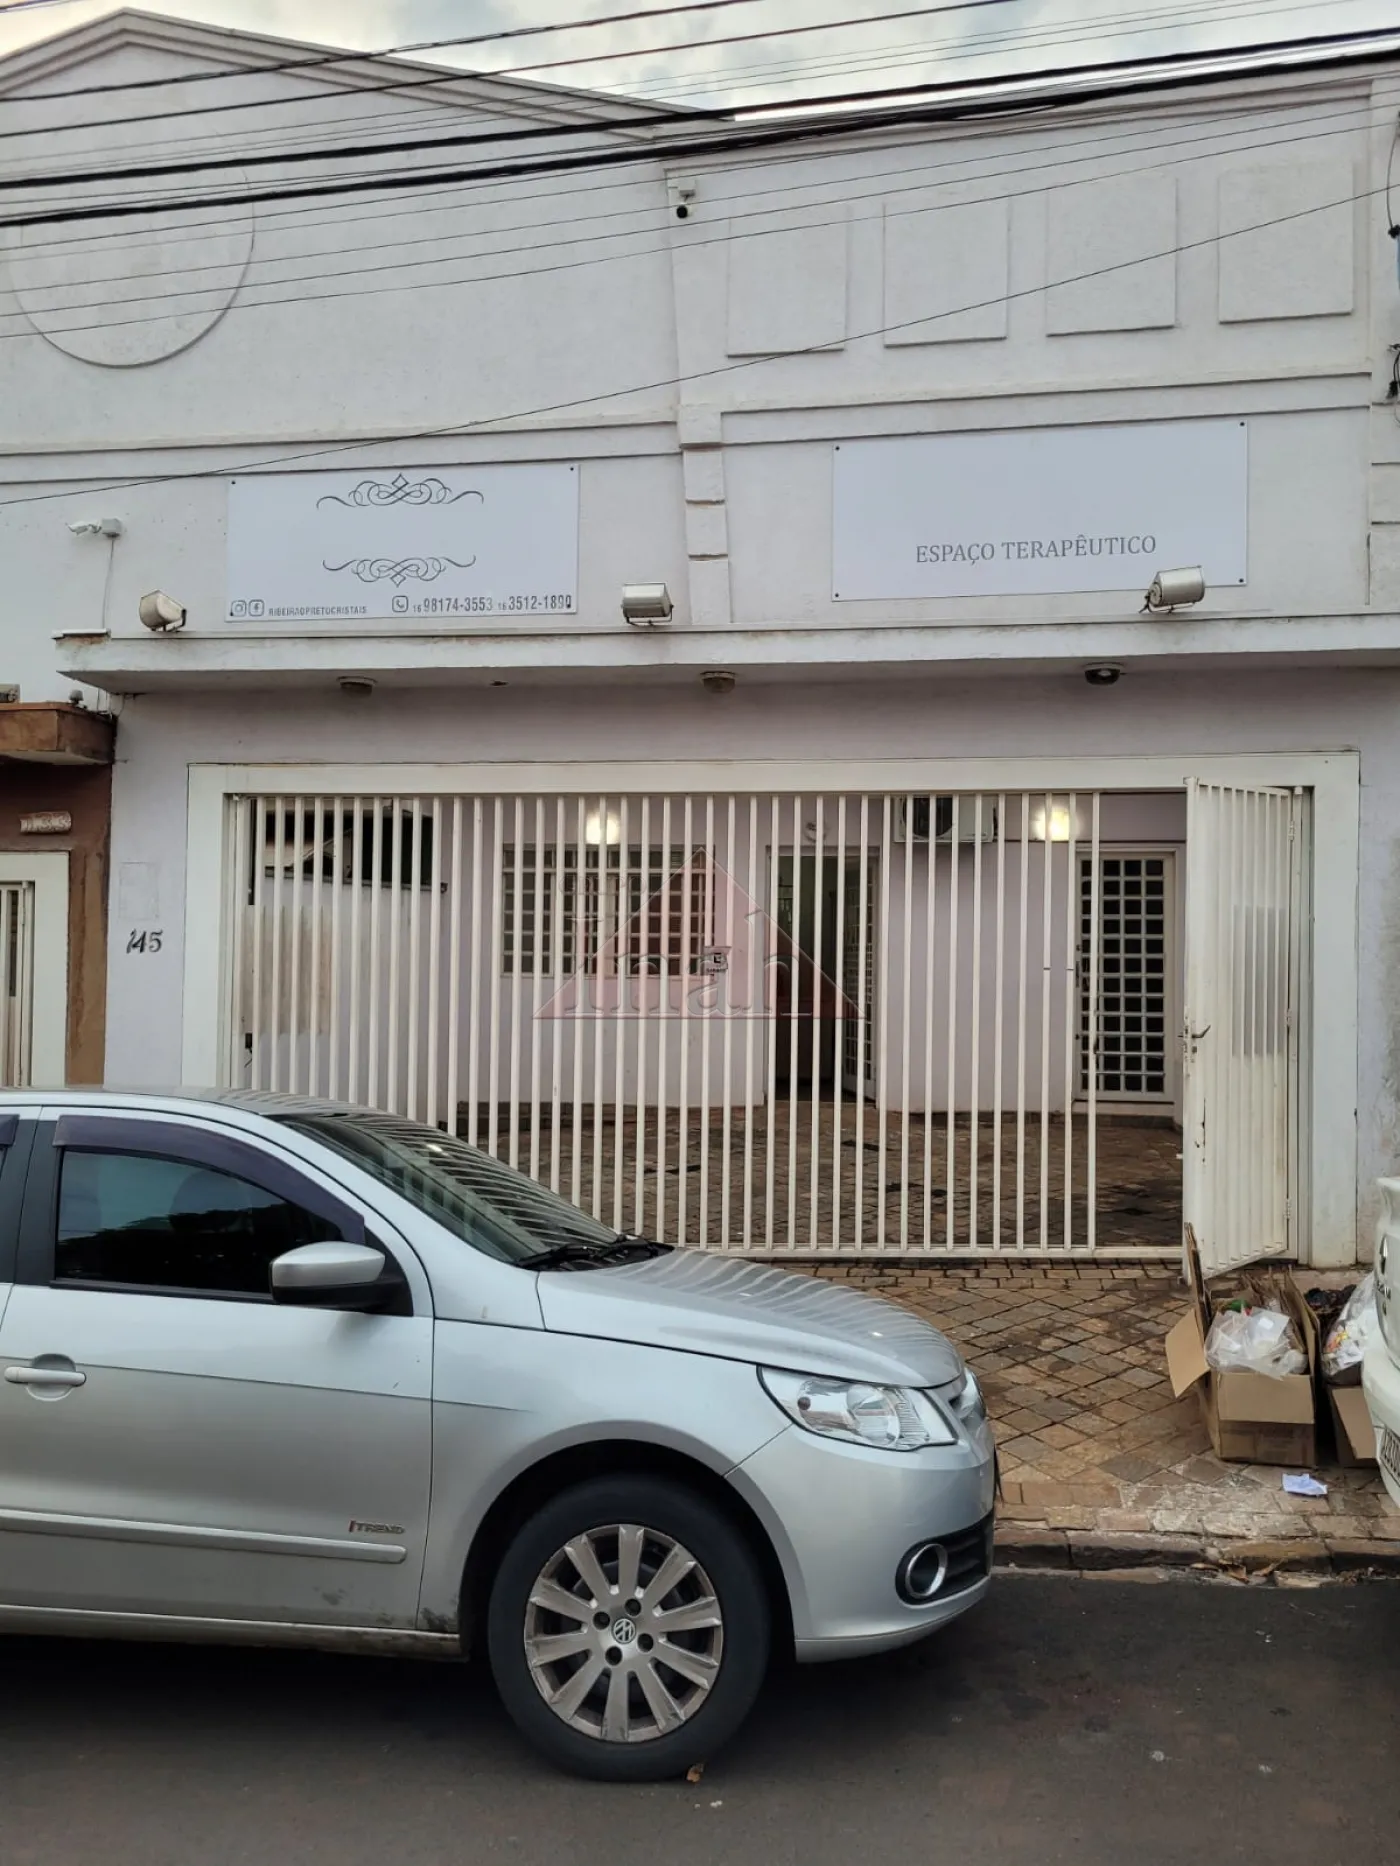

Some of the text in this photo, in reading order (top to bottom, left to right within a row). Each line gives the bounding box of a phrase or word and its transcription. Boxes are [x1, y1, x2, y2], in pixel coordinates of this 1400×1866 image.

[916, 534, 1157, 565] ESPAÇO TERAPÊUTICO
[423, 597, 493, 613] 98174-3553
[125, 928, 164, 955] 145
